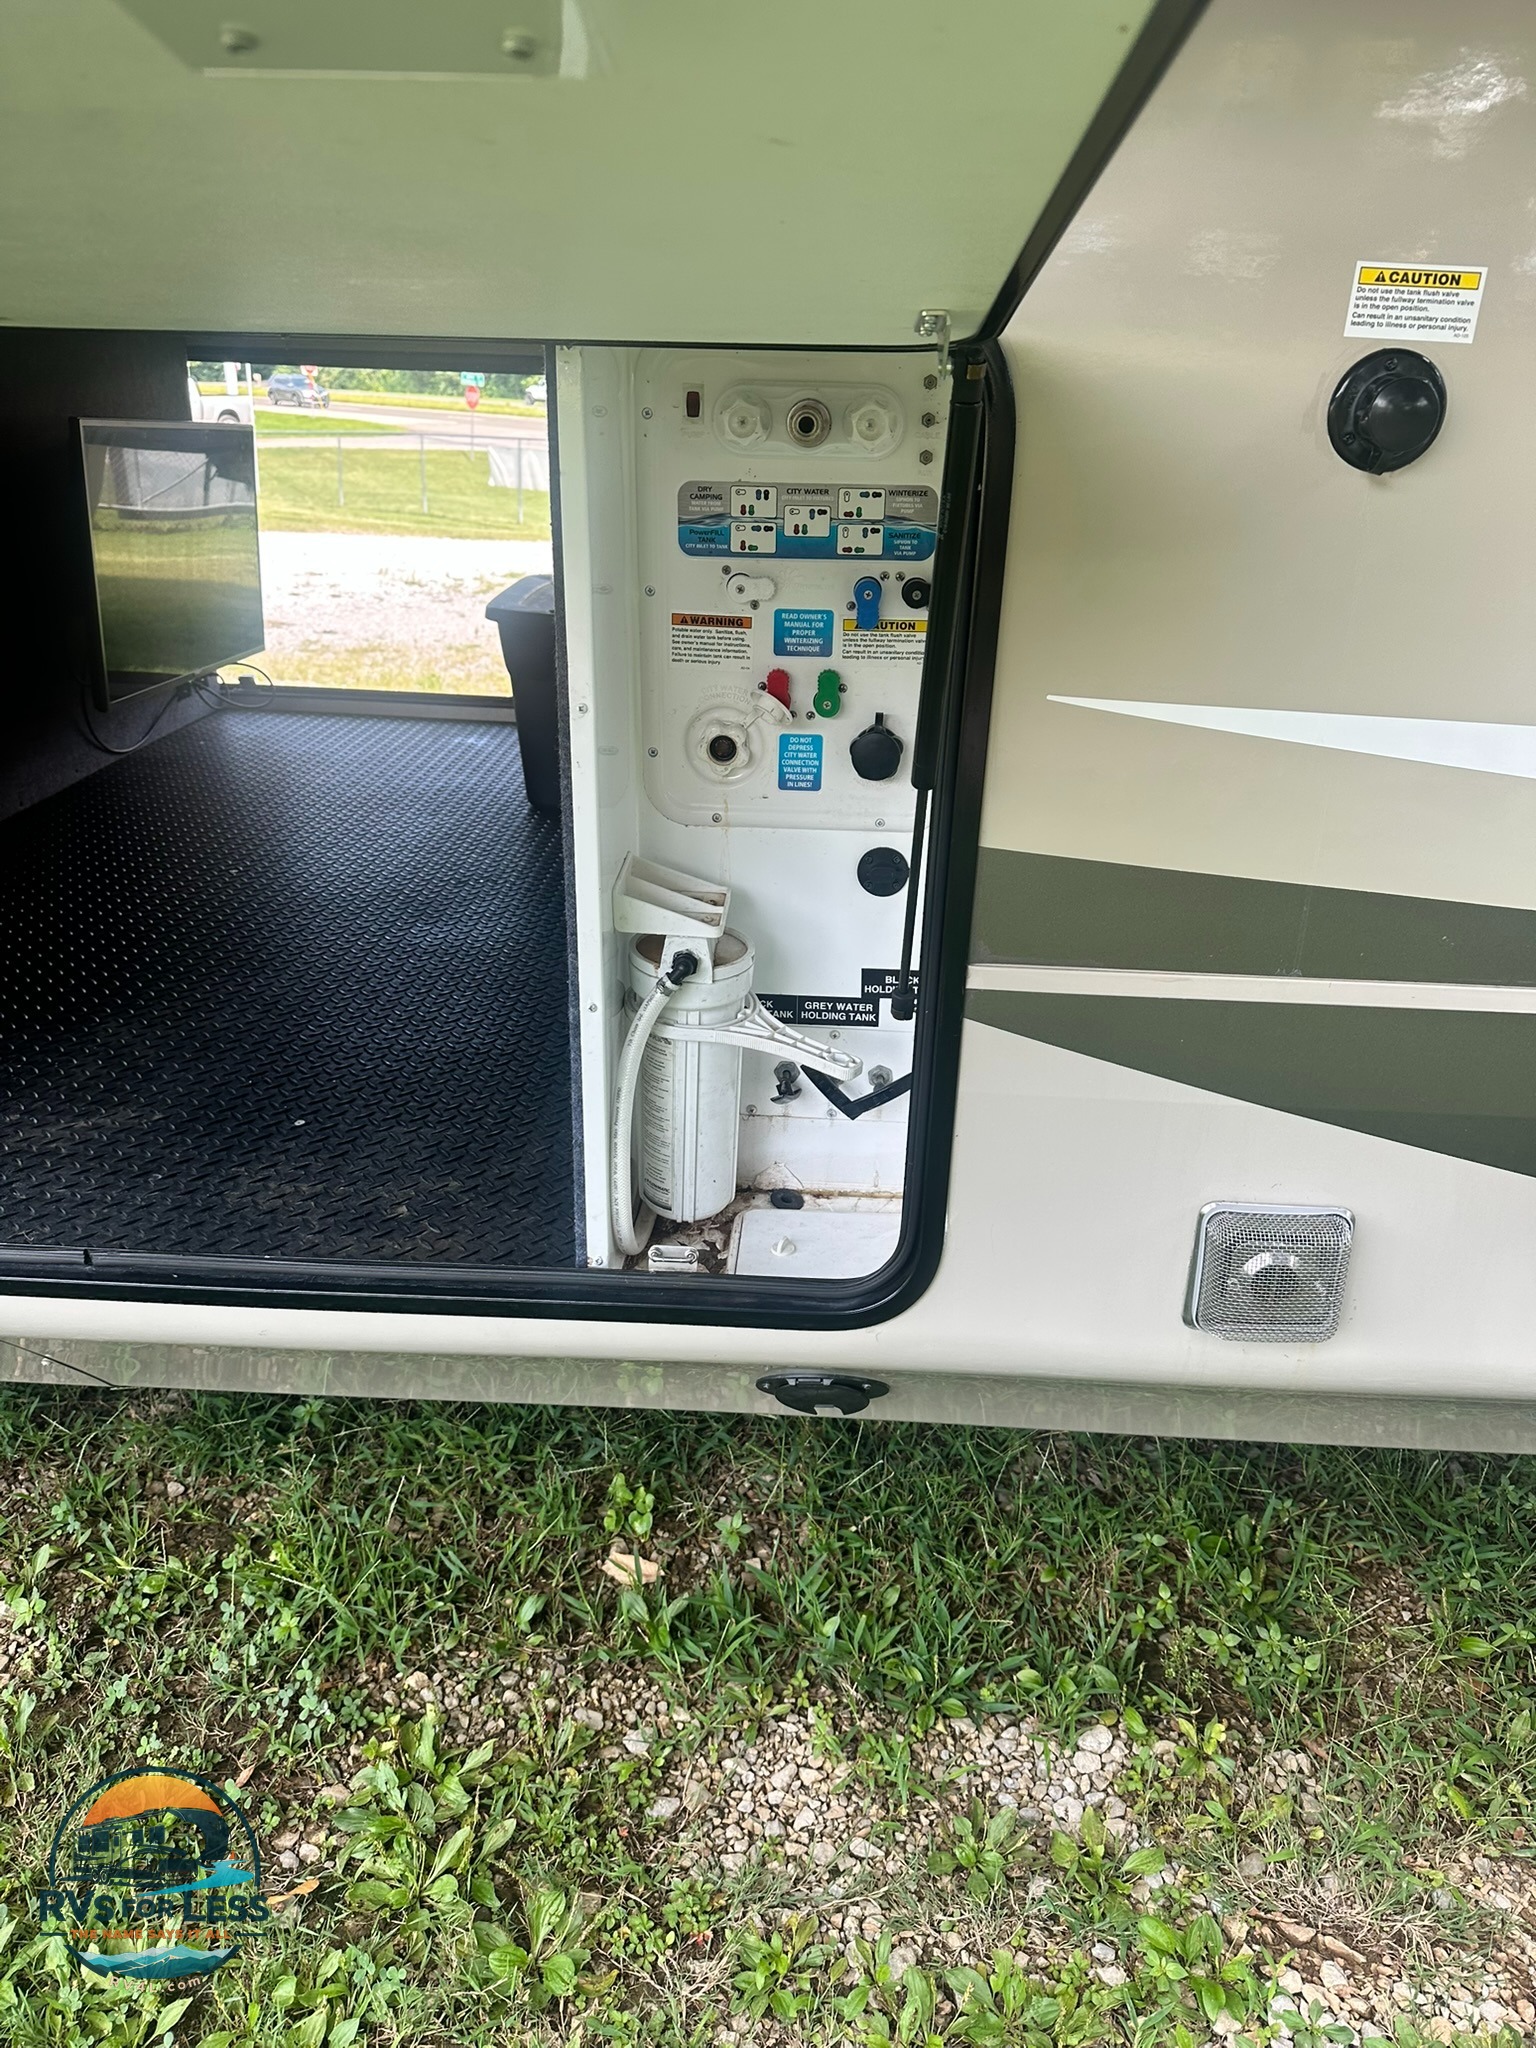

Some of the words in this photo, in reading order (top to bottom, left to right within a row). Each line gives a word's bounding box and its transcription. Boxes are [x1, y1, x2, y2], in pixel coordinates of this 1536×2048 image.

[1389, 271, 1461, 286] CAUTION
[1391, 296, 1415, 304] fullway
[1417, 298, 1455, 306] termination
[1404, 314, 1438, 323] unsanitary
[1351, 320, 1374, 328] leading
[690, 616, 743, 626] WARNING
[872, 622, 916, 630] UTION
[885, 976, 919, 984] BLCK
[805, 1002, 832, 1010] GREY
[836, 1002, 873, 1012] WATER
[801, 1012, 846, 1021] HOLDING
[849, 1013, 877, 1022] TANK
